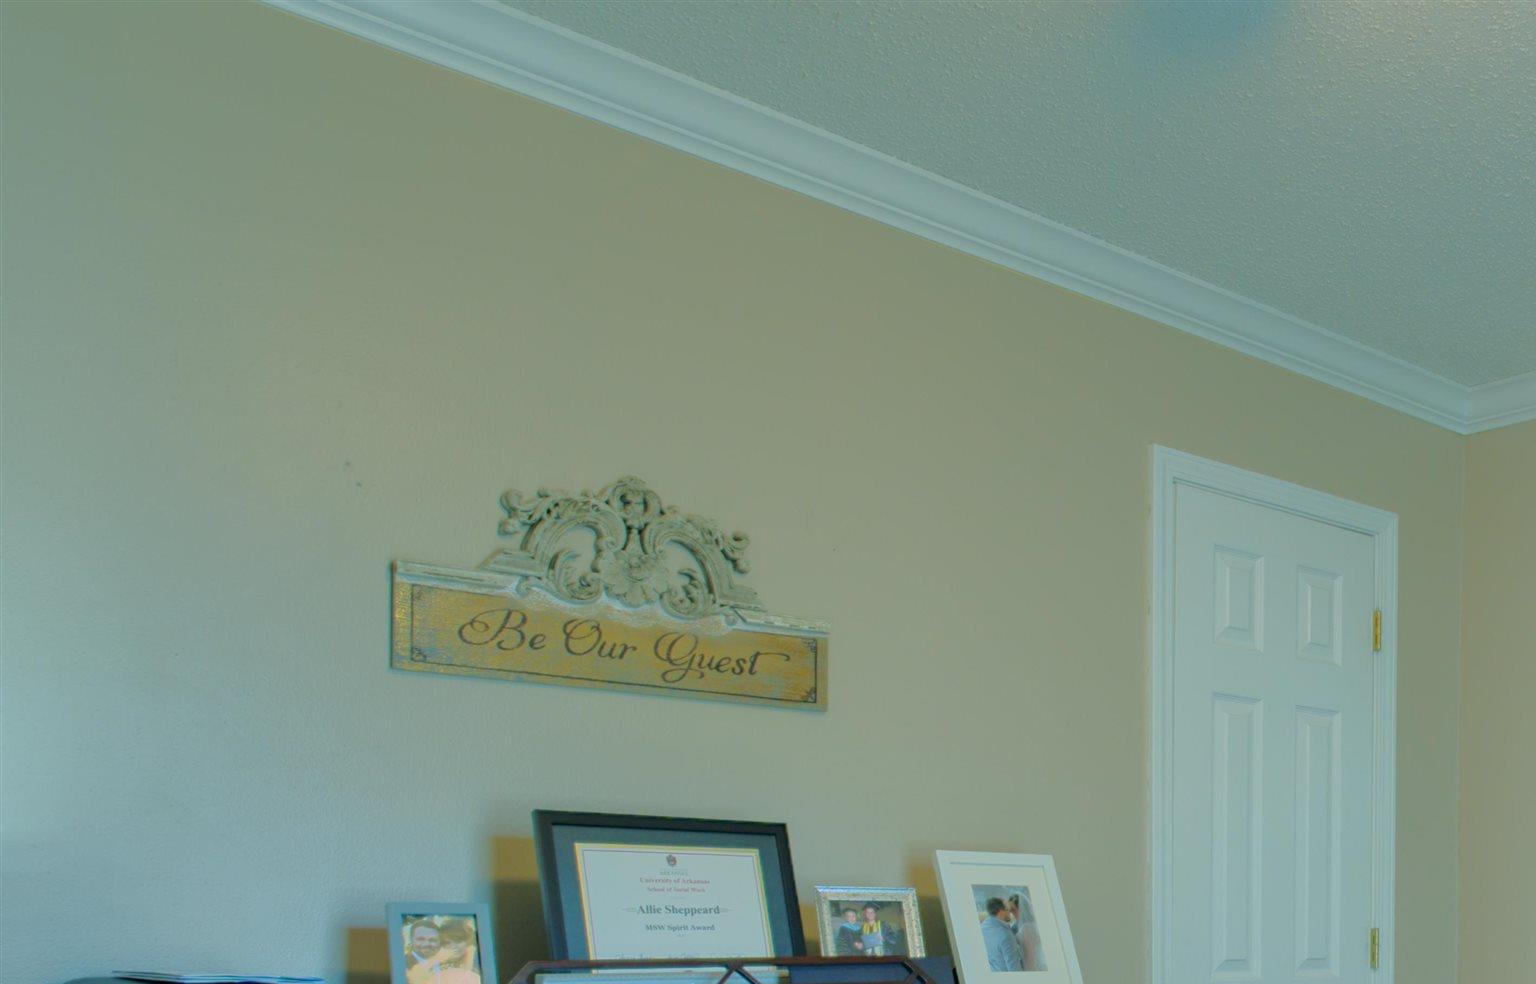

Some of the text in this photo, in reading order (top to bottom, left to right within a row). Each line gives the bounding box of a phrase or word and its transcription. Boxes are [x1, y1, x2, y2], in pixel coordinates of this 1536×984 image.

[458, 608, 791, 684] Be Our Guest
[638, 904, 720, 916] Allie Sheppeard
[667, 924, 688, 932] Spirit
